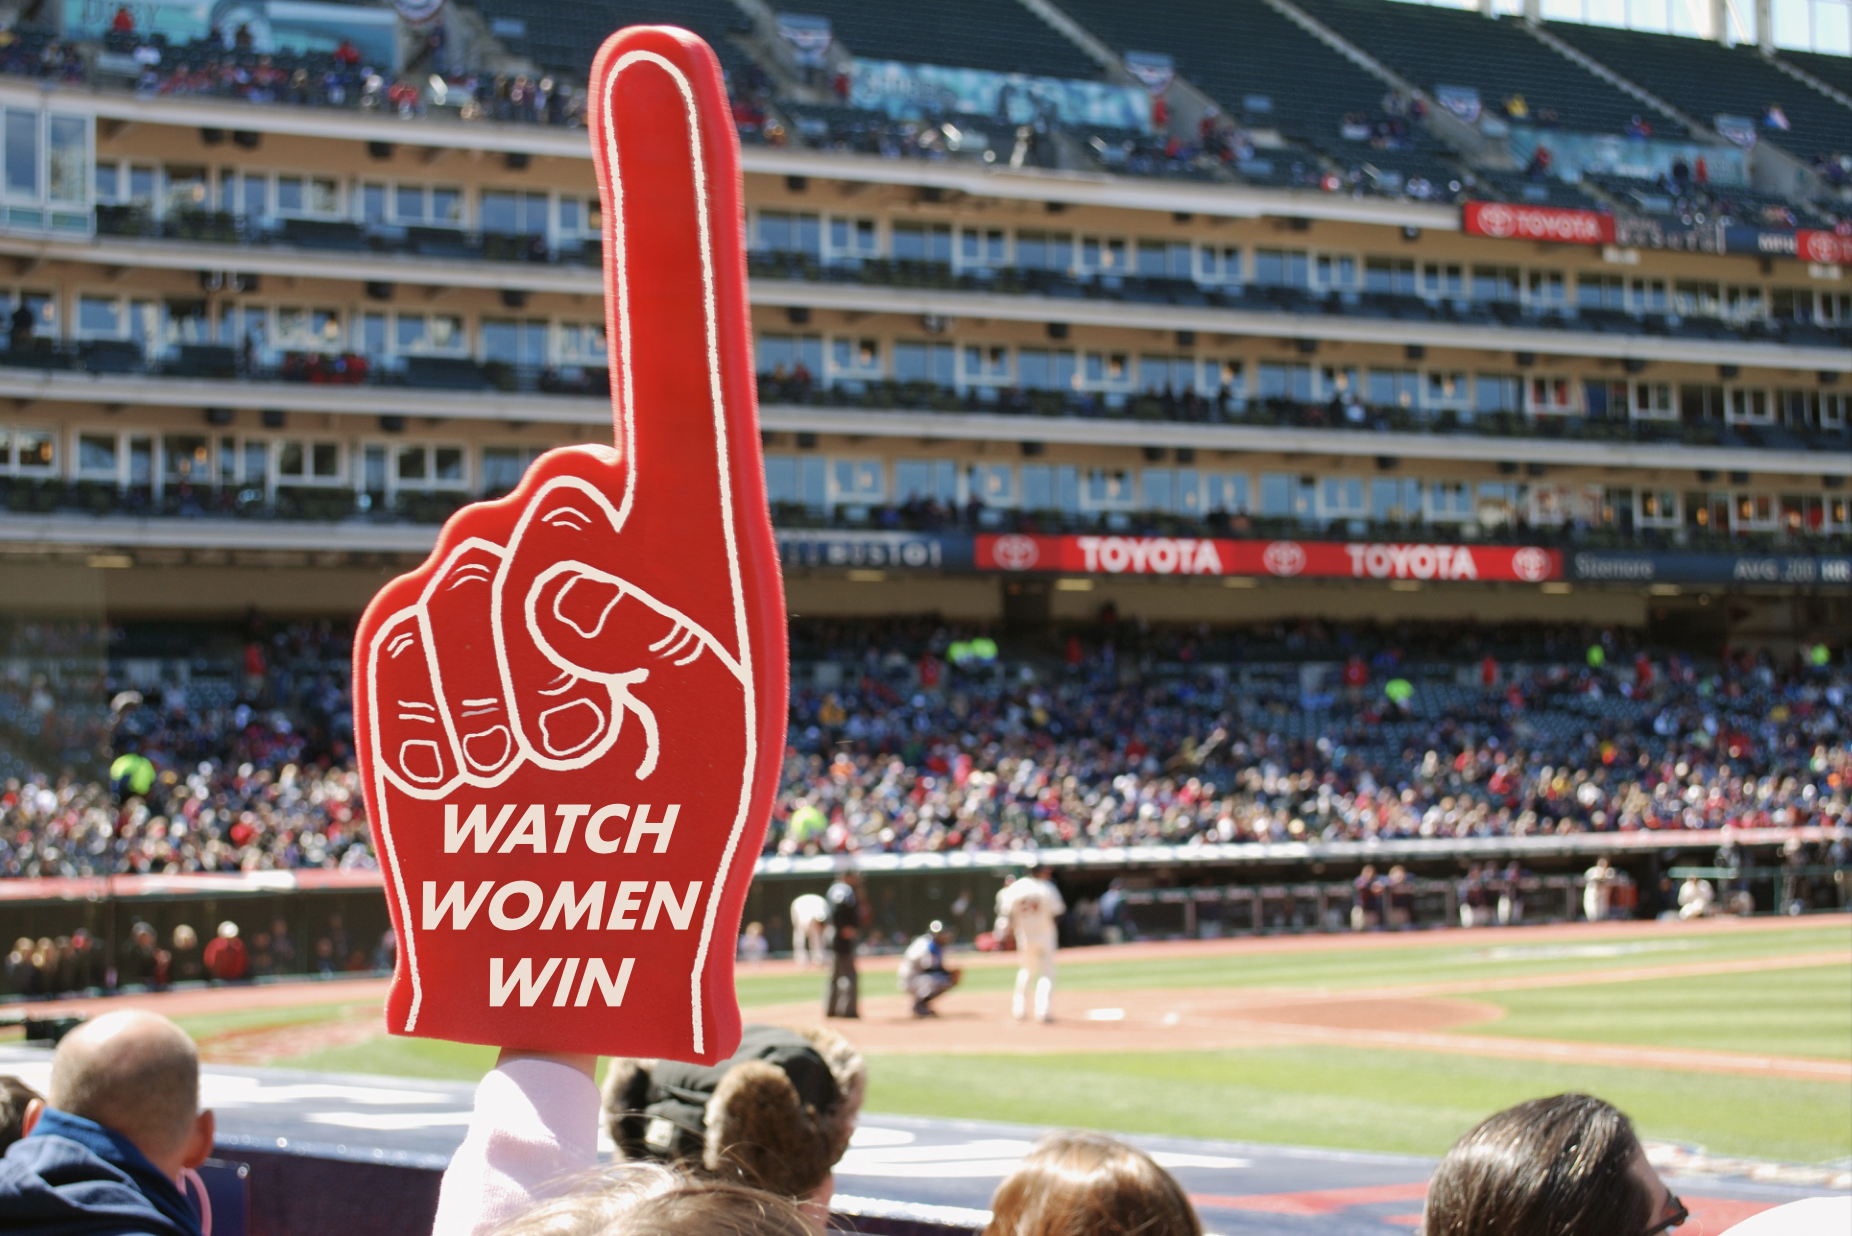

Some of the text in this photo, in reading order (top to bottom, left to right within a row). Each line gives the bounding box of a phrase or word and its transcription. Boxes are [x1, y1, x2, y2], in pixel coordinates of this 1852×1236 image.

[1515, 208, 1601, 241] TOYOTA
[1078, 536, 1223, 575] TOYOTA
[1345, 543, 1478, 581] TOYOTA
[444, 803, 681, 854] WATCH
[422, 880, 703, 931] WOMEN
[489, 957, 636, 1007] WIN
